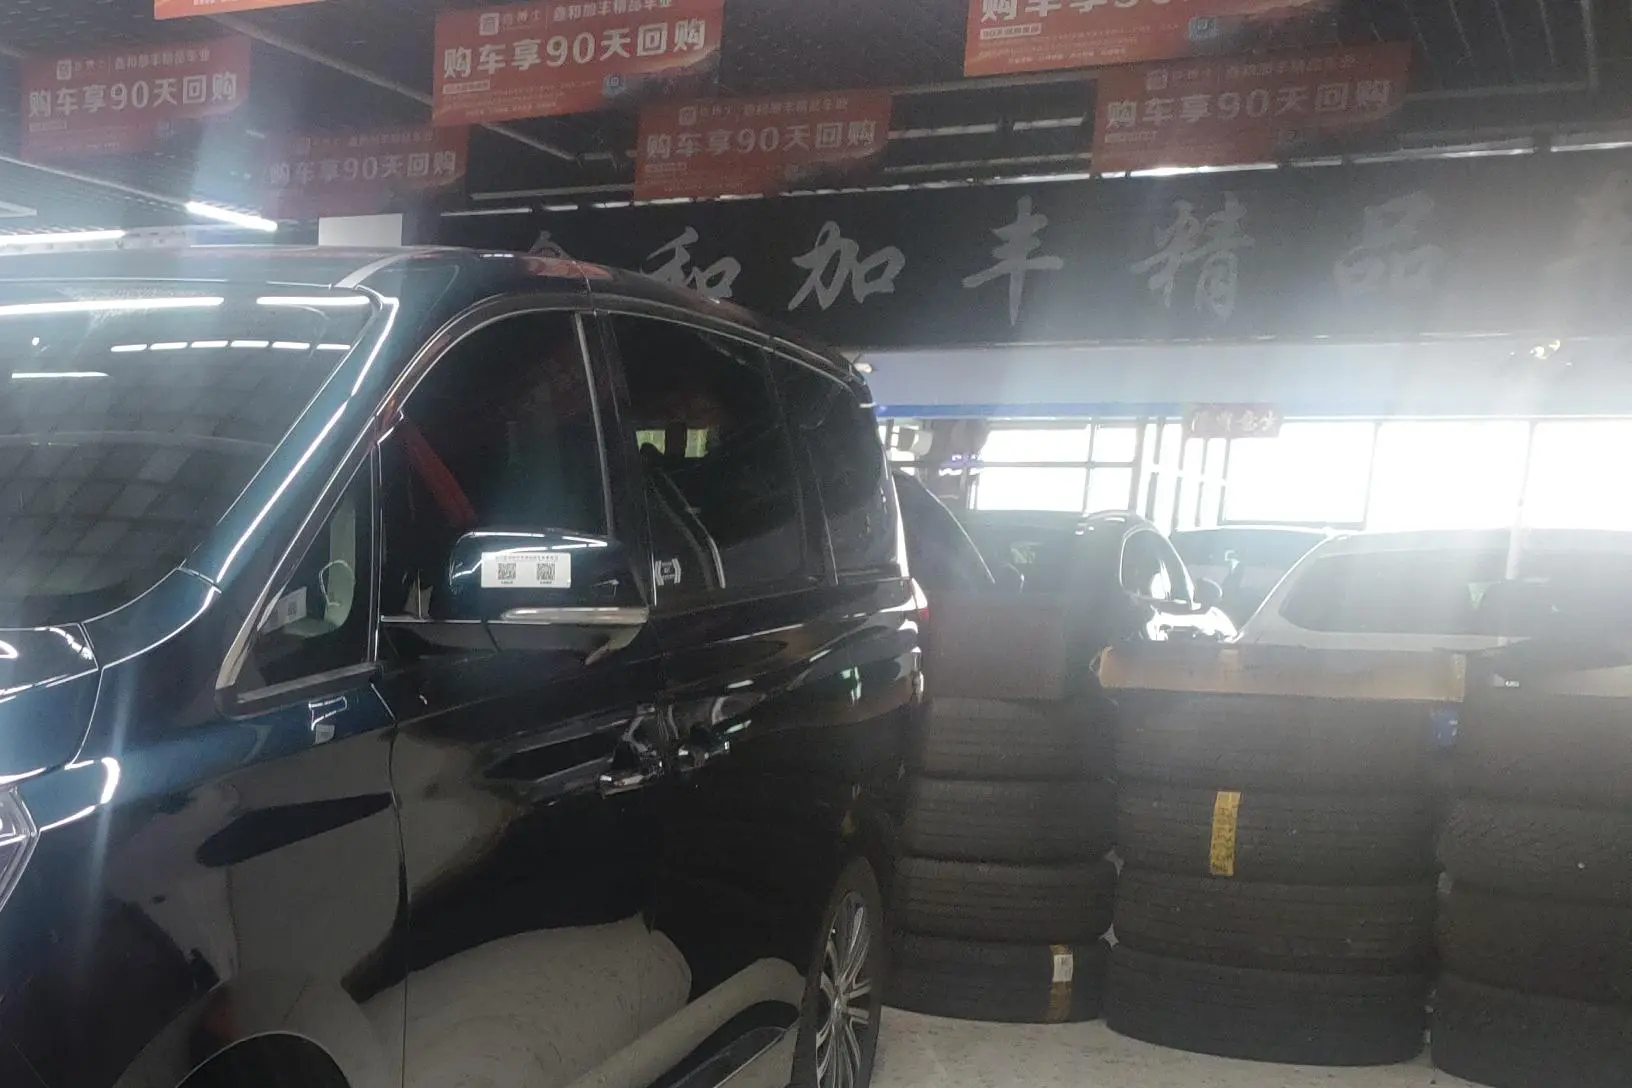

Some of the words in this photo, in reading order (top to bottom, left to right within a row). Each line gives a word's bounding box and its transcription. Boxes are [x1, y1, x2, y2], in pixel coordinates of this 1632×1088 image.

[442, 18, 706, 78] 购车享90天回购
[28, 71, 238, 118] 购车享90天回购
[1105, 79, 1391, 129] 购车享90天回购
[646, 119, 877, 159] 购车享90天回购
[269, 150, 457, 185] 购车享90天回购
